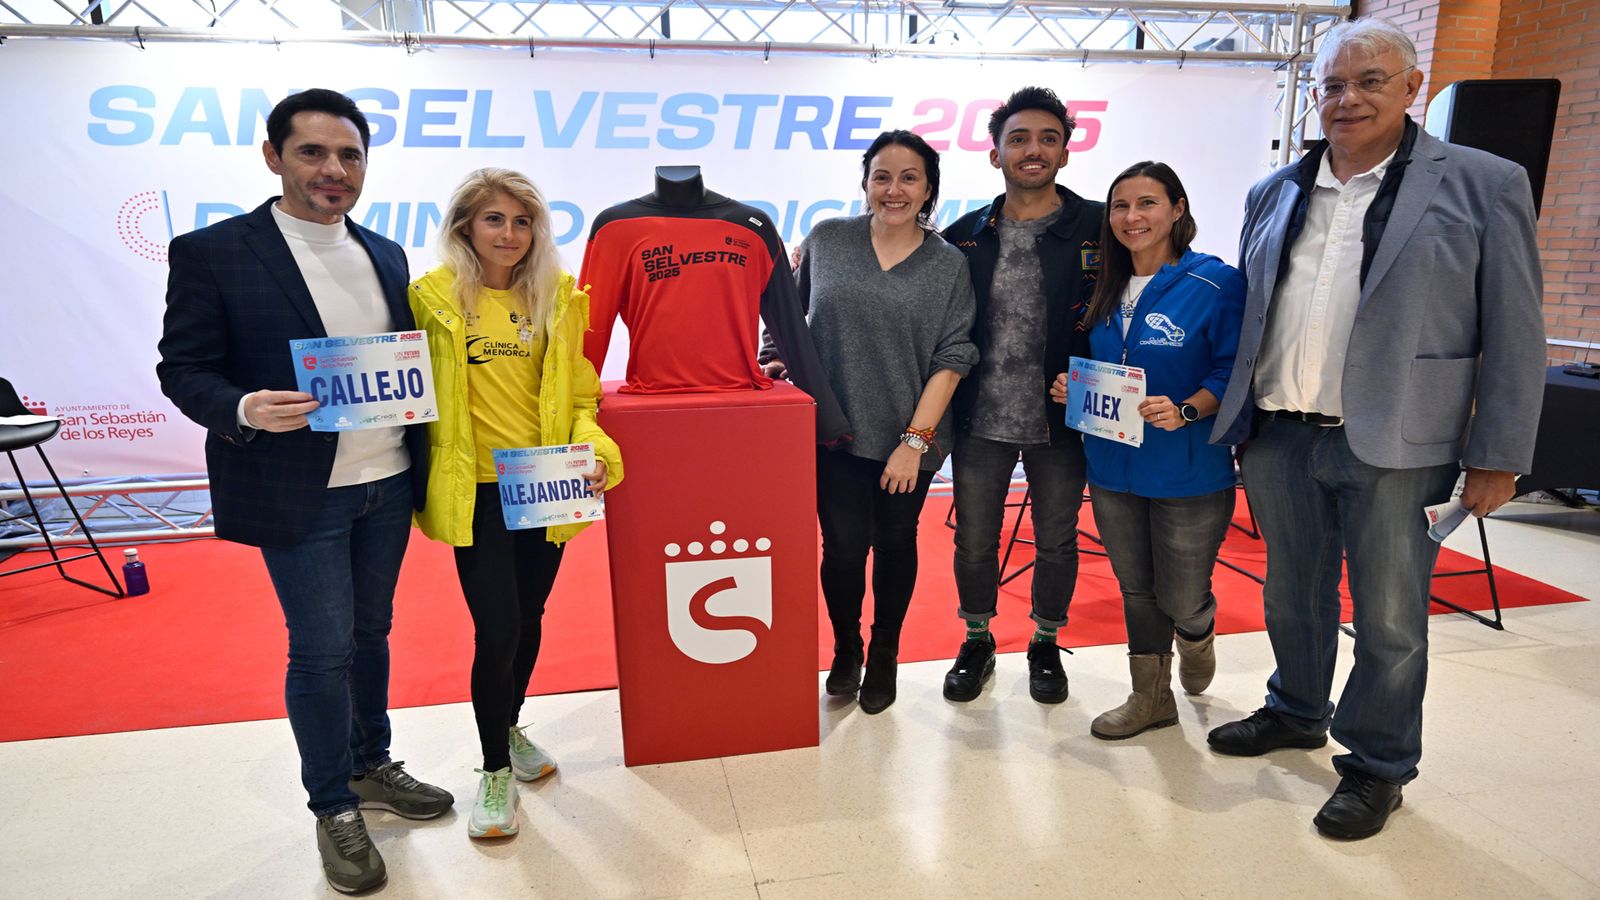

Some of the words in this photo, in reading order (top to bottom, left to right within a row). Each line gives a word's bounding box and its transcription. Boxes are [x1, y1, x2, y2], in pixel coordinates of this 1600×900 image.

[350, 87, 893, 150] SELVESTRE
[909, 97, 1109, 153] 205
[641, 244, 673, 261] SAN
[644, 250, 748, 273] SELVESTRE
[649, 266, 681, 282] 2025
[325, 334, 398, 349] SELVESTRE
[399, 332, 422, 340] 2025
[483, 341, 519, 350] CLÍNICA
[483, 349, 531, 358] MENORCA
[310, 367, 425, 408] CALLEJO
[54, 404, 118, 412] AYUNTAMIENTO
[1083, 390, 1121, 422] ALEX
[57, 413, 87, 426] San
[90, 410, 167, 425] Sebastián
[60, 427, 81, 440] de
[83, 426, 105, 440] los
[108, 426, 154, 441] Reyes
[501, 477, 594, 506] ALEJANDRA
